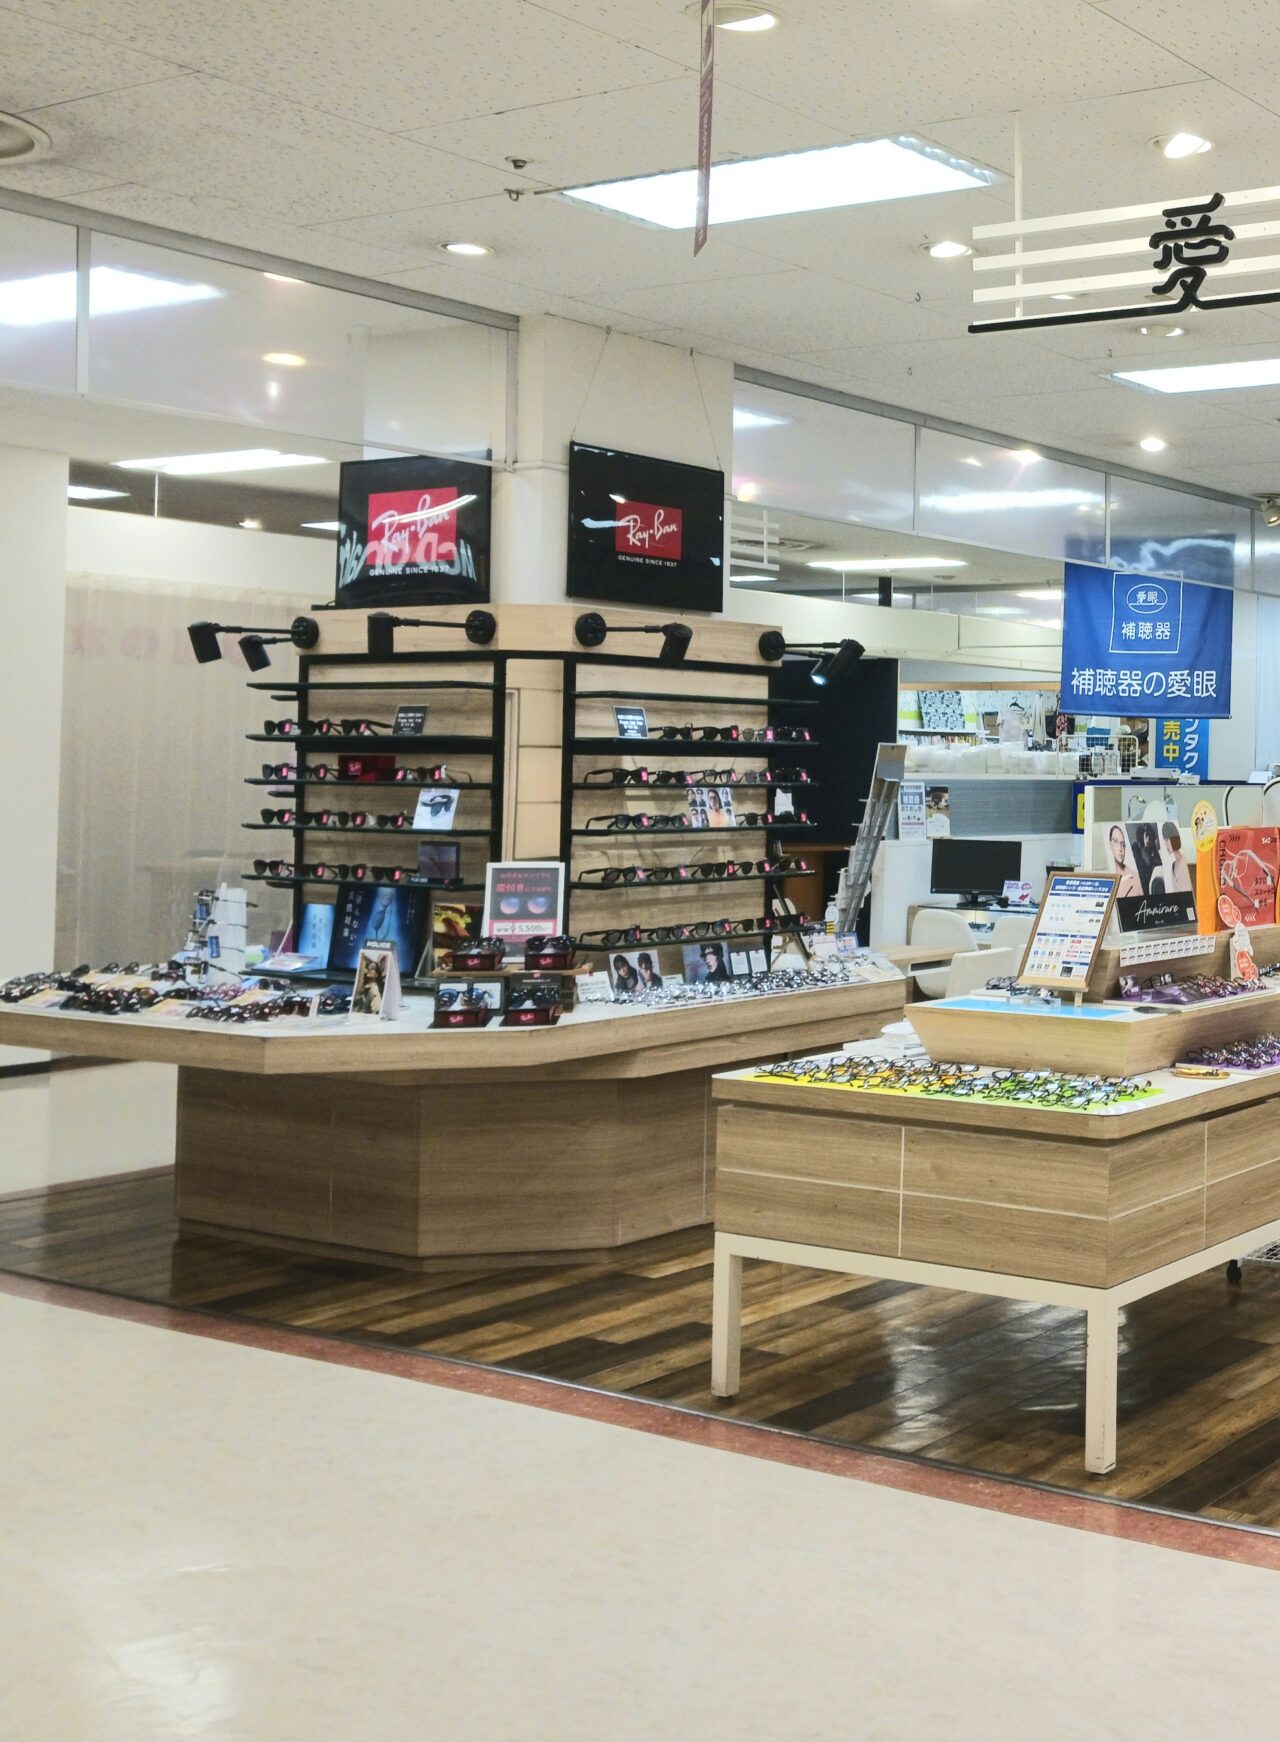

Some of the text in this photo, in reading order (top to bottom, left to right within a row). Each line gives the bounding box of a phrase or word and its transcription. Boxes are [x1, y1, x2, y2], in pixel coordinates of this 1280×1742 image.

[618, 554, 644, 564] GENUINE
[645, 558, 663, 566] SINCE
[369, 567, 402, 576] GENUINE
[405, 566, 429, 574] SINCE
[1136, 590, 1159, 604] 愛眼
[1121, 621, 1171, 640] 補聴器
[1071, 667, 1217, 698] 補聴器の愛眼
[1184, 719, 1199, 775] ンタク
[366, 940, 391, 949] POLICE
